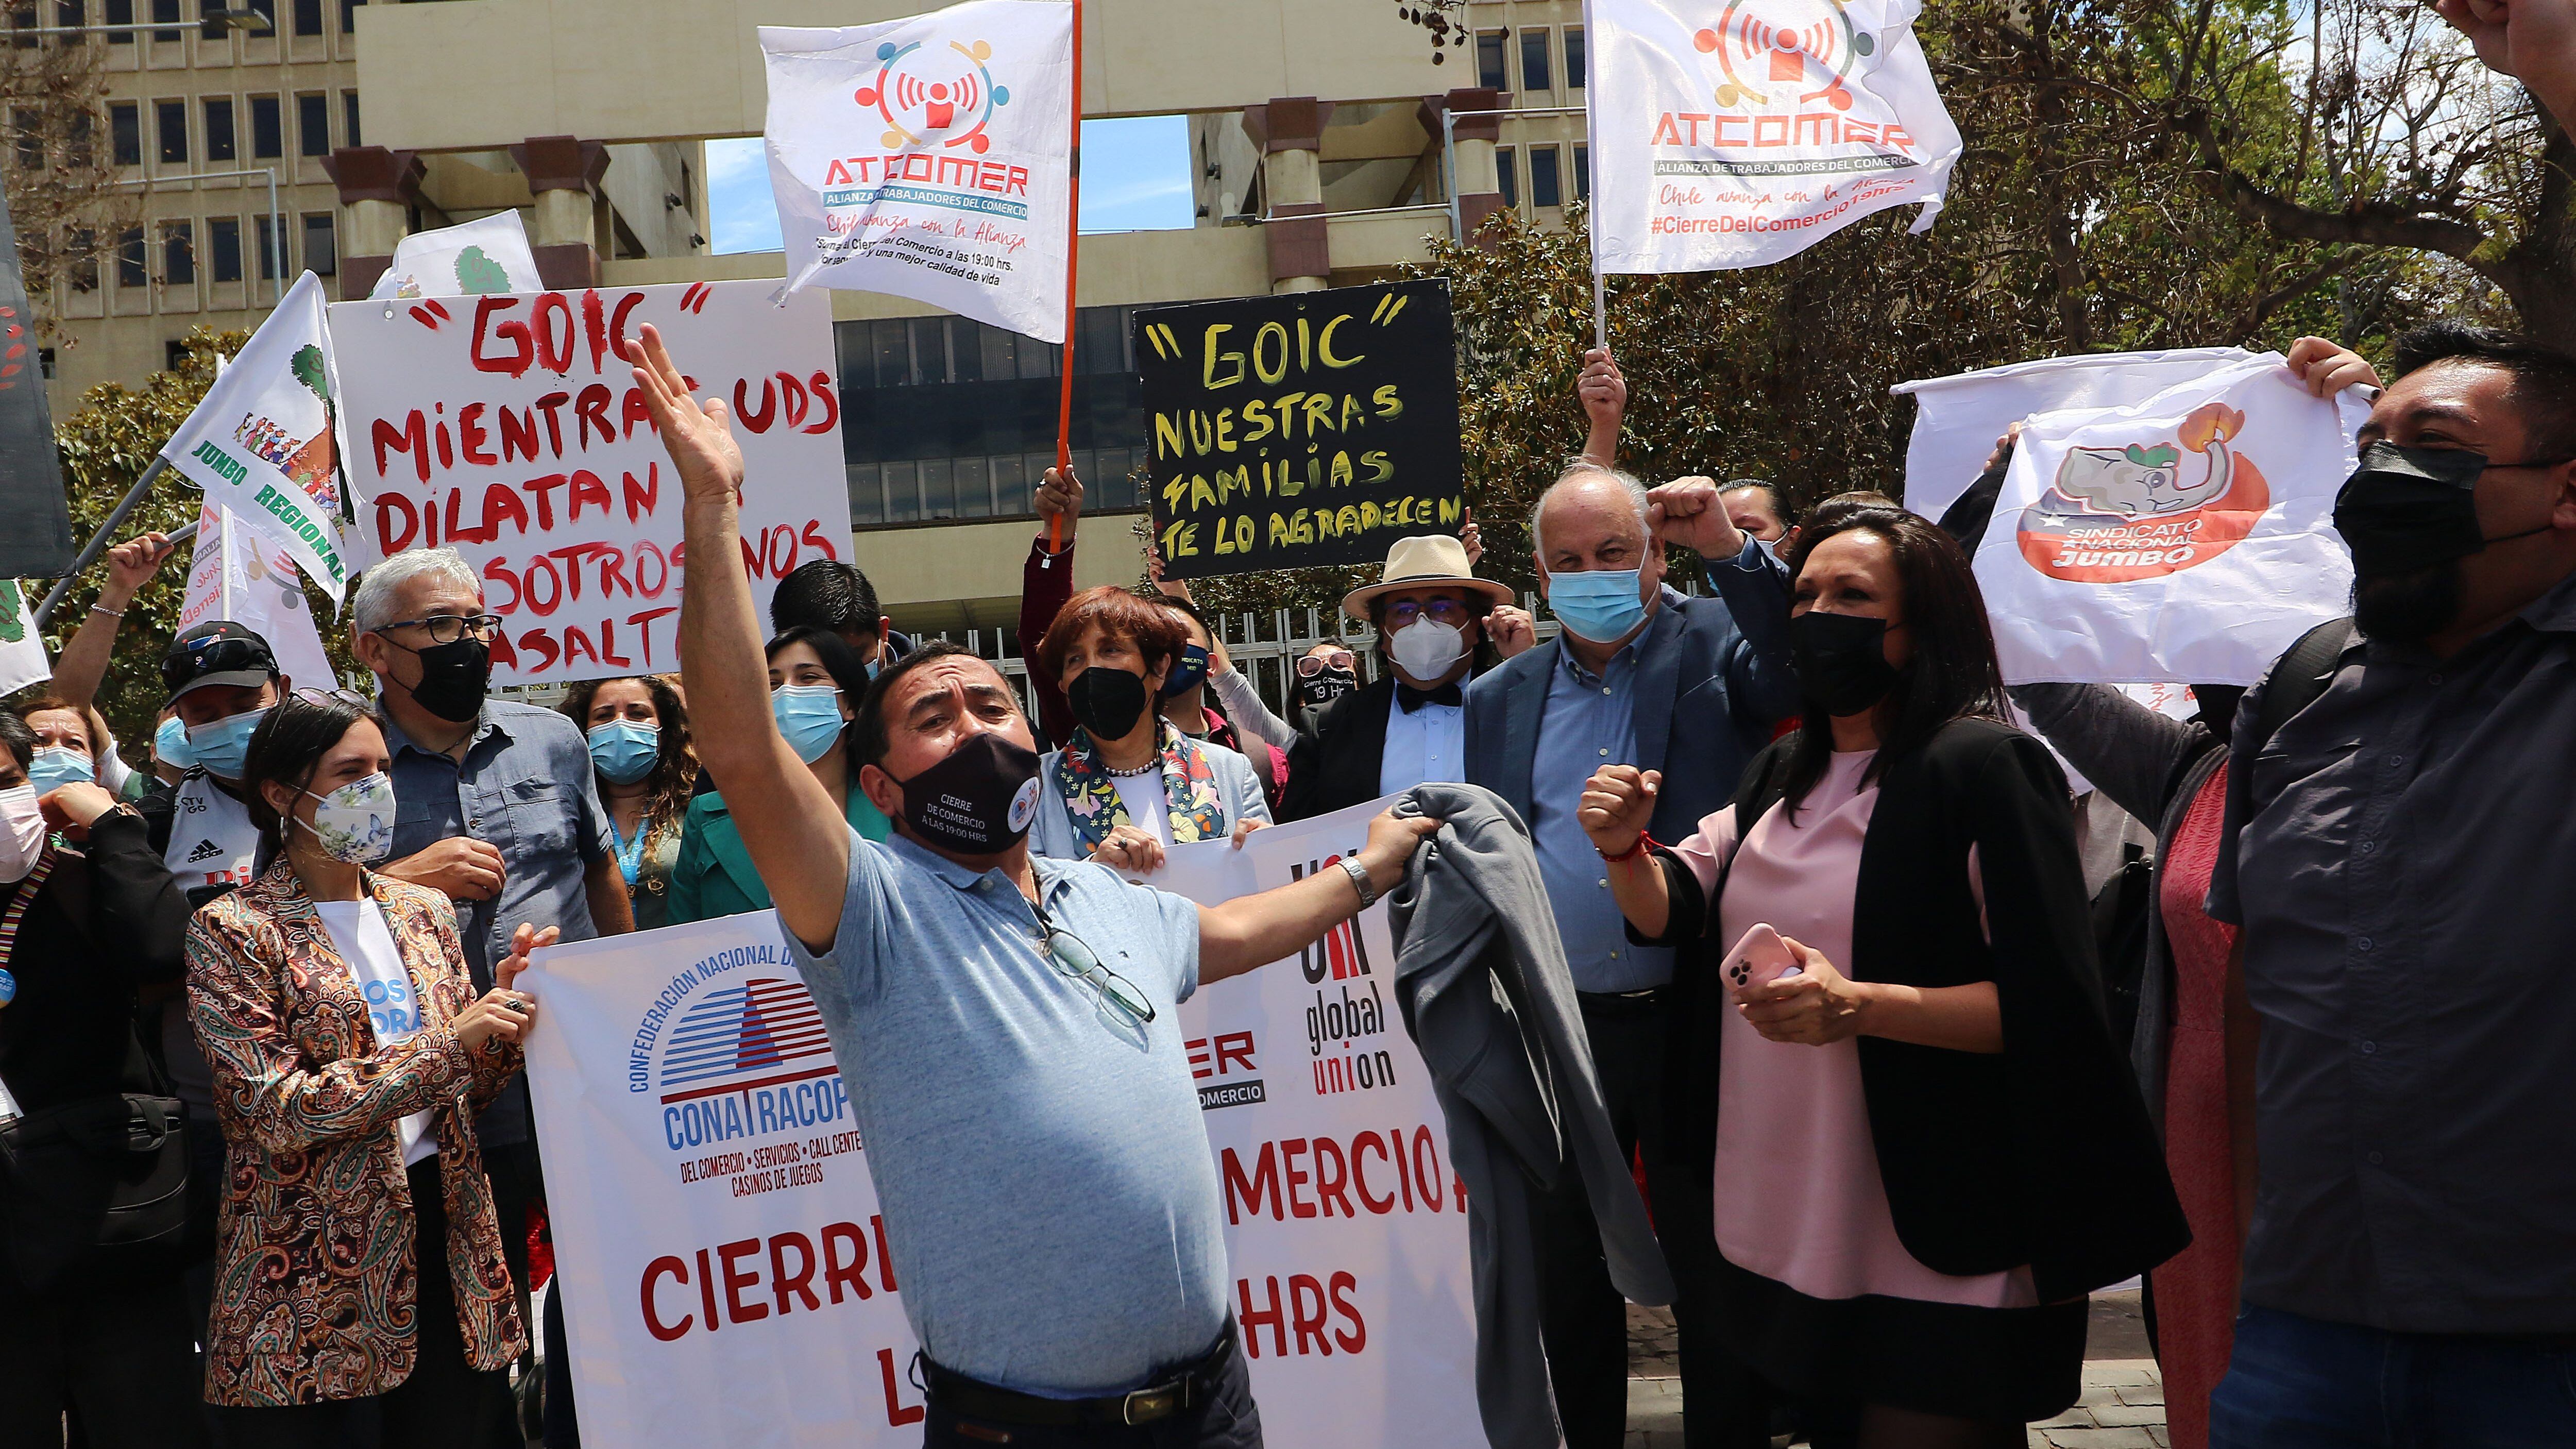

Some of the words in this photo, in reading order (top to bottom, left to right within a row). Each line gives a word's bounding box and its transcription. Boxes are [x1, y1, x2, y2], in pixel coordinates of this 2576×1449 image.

[1650, 112, 1915, 156] ATCOMER
[825, 154, 1029, 197] ATCOMER
[1657, 162, 1709, 174] ALIANZA
[1713, 163, 1728, 174] DE
[1730, 161, 1826, 174] TRABAJADORES
[1828, 160, 1851, 171] DEL
[826, 192, 874, 204] ALIANZA
[879, 189, 961, 205] TRABAJADORES
[963, 196, 980, 208] DEL
[981, 200, 1027, 216] COMERCIO
[1660, 184, 1704, 206] Chile
[1785, 192, 1811, 203] con
[1824, 184, 1839, 201] la
[896, 237, 944, 257] Comercio
[946, 249, 953, 258] a
[955, 250, 968, 263] las
[971, 252, 994, 267] 19:00
[996, 257, 1013, 271] hrs.
[922, 221, 943, 233] con
[955, 217, 965, 237] la
[975, 220, 1026, 254] Alianza
[896, 252, 926, 266] mejor
[927, 259, 965, 278] calidad
[967, 268, 979, 282] de
[980, 273, 1000, 285] vida
[732, 369, 838, 435] UDS
[1155, 384, 1403, 460] NUESTRAS
[192, 440, 248, 485] JUMBO
[254, 484, 345, 584] REGIONAL
[1160, 519, 1199, 561] TE
[1214, 516, 1255, 555] LO
[1269, 495, 1461, 551] AGRADECEN
[2066, 519, 2202, 538] SINDICATO
[2079, 533, 2198, 550] NACIONAL
[2052, 547, 2195, 567] JUMBO
[487, 606, 681, 673] ASALT
[1314, 686, 1325, 699] 19
[927, 803, 938, 815] DE
[939, 808, 985, 829] COMERCIO
[941, 794, 972, 812] CIERRE
[922, 815, 928, 824] A
[928, 818, 944, 831] LAS
[946, 825, 967, 838] 19:00
[969, 831, 987, 842] HRS
[188, 849, 224, 863] adidas
[629, 969, 699, 1093] CONFEDERACIÓN
[695, 945, 776, 980] NACIONAL
[1307, 981, 1385, 1056] global
[1313, 1041, 1396, 1096] union
[681, 1161, 699, 1184] DEL
[699, 1152, 745, 1180] COMERCIO
[753, 1142, 800, 1169] SERVICIOS
[809, 1134, 832, 1159] CALL
[833, 1130, 862, 1154] CENTE
[1221, 1124, 1443, 1225] MERCIO
[732, 1172, 772, 1197] CASINOS
[774, 1168, 787, 1189] DE
[790, 1162, 823, 1187] JUEGOS
[1238, 1270, 1367, 1360] HRS
